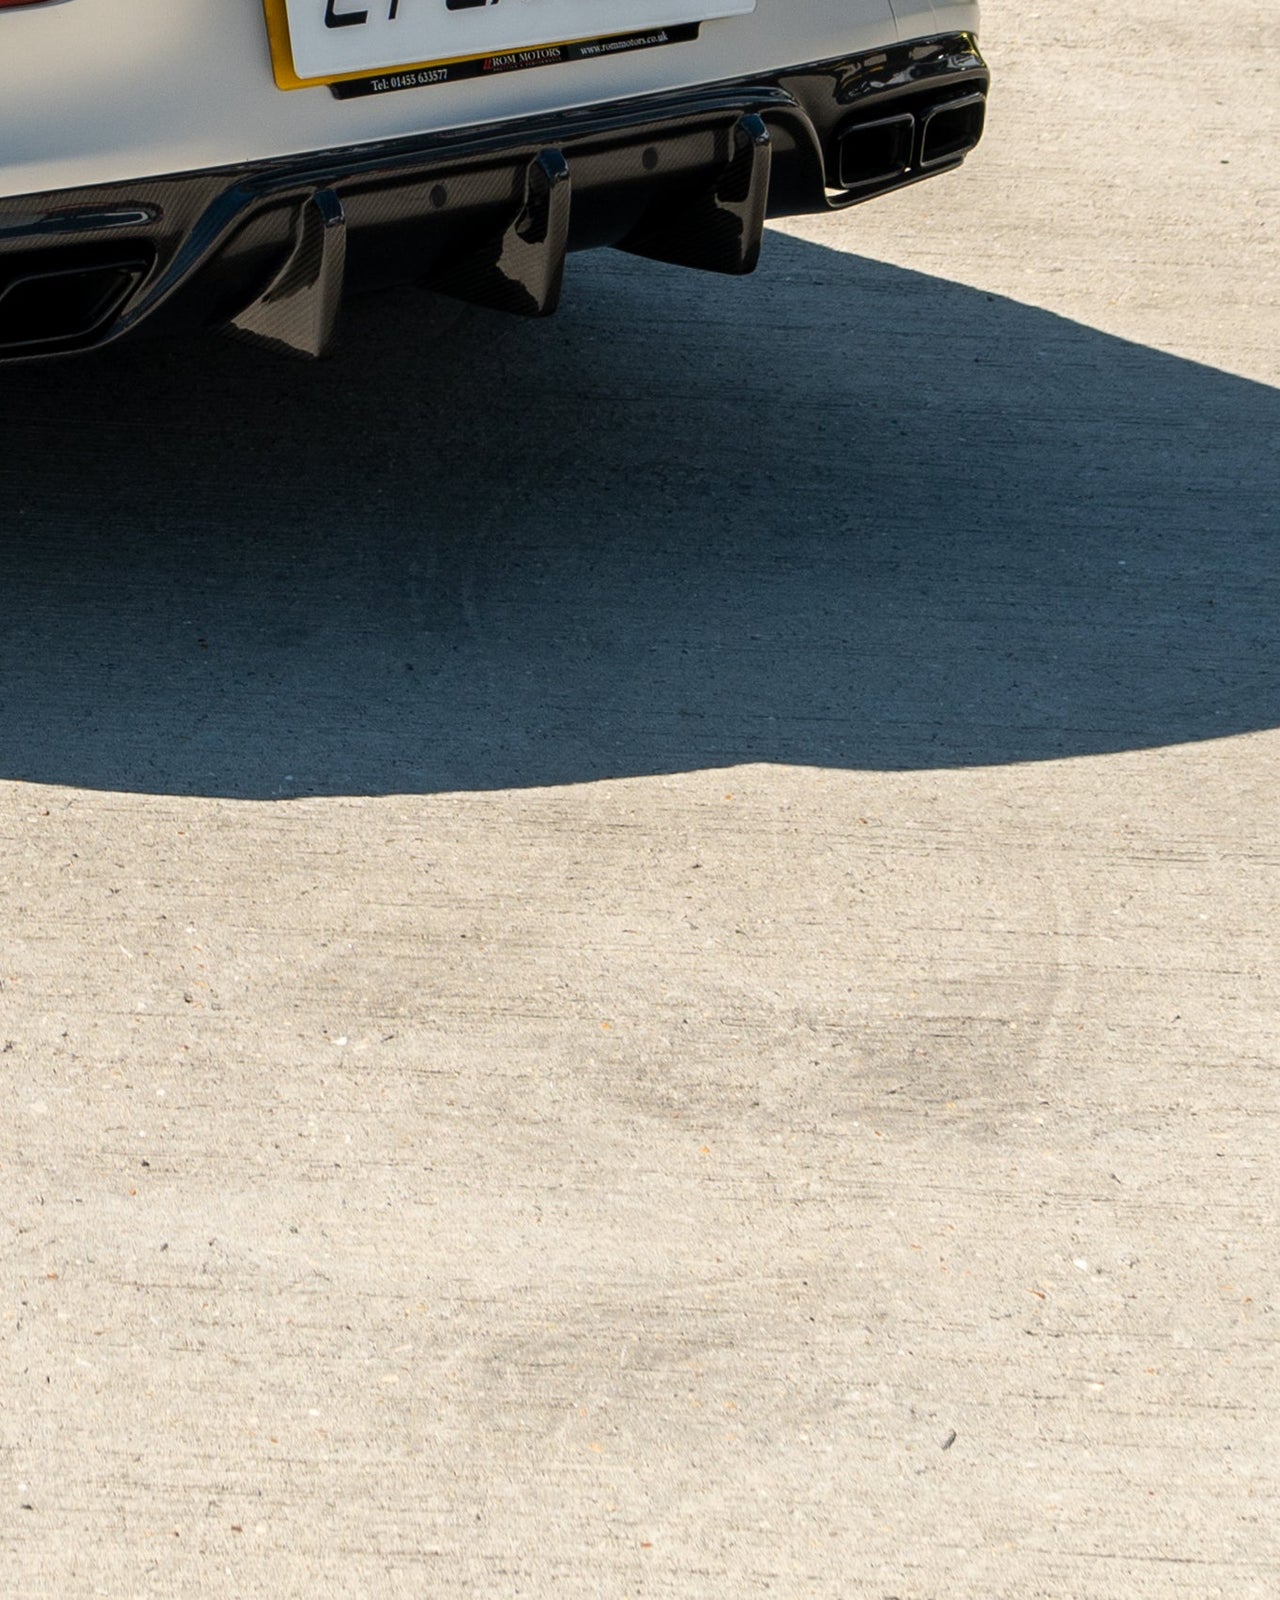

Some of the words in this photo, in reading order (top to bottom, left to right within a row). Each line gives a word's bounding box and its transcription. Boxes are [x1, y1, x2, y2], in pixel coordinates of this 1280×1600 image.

[580, 31, 669, 56] www.rommotors.co.uk
[492, 54, 516, 67] ROM
[518, 46, 561, 63] MOTORS
[370, 78, 390, 92] Tel:
[390, 72, 417, 89] 01455
[417, 68, 448, 85] 633577
